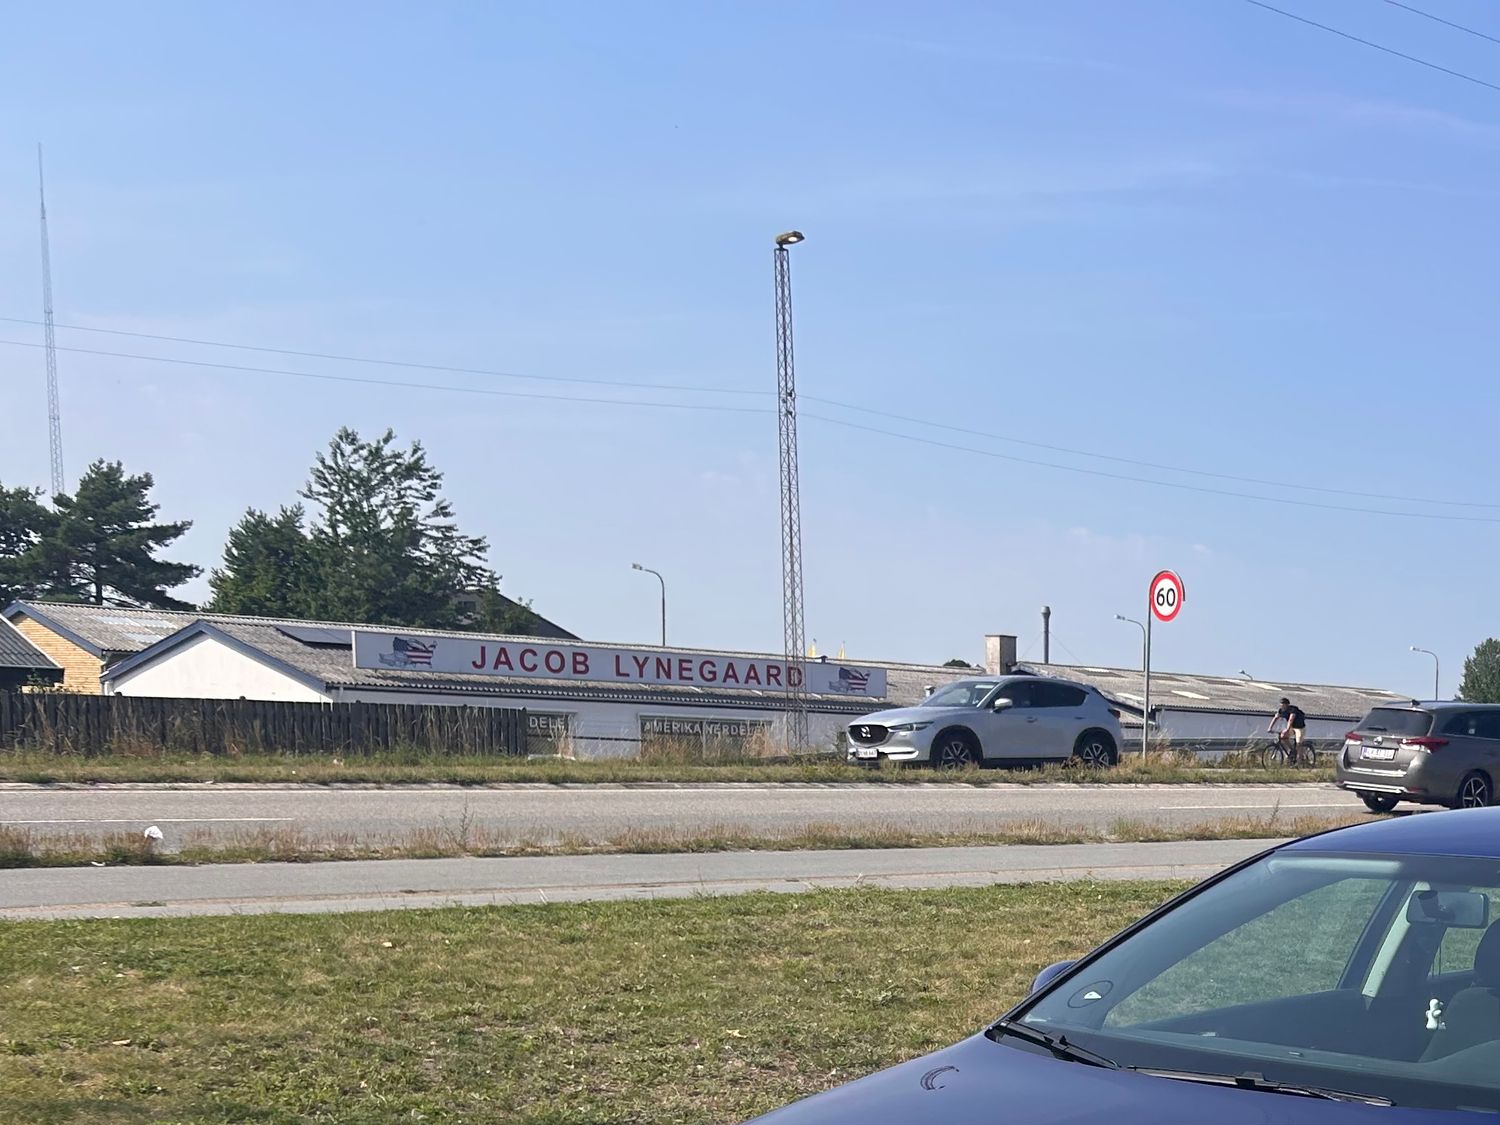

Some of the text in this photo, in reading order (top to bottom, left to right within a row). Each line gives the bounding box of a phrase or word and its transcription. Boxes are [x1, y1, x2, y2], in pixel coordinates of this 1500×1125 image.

[1156, 587, 1176, 607] 60
[472, 646, 803, 688] JACOB LYNEGAARD
